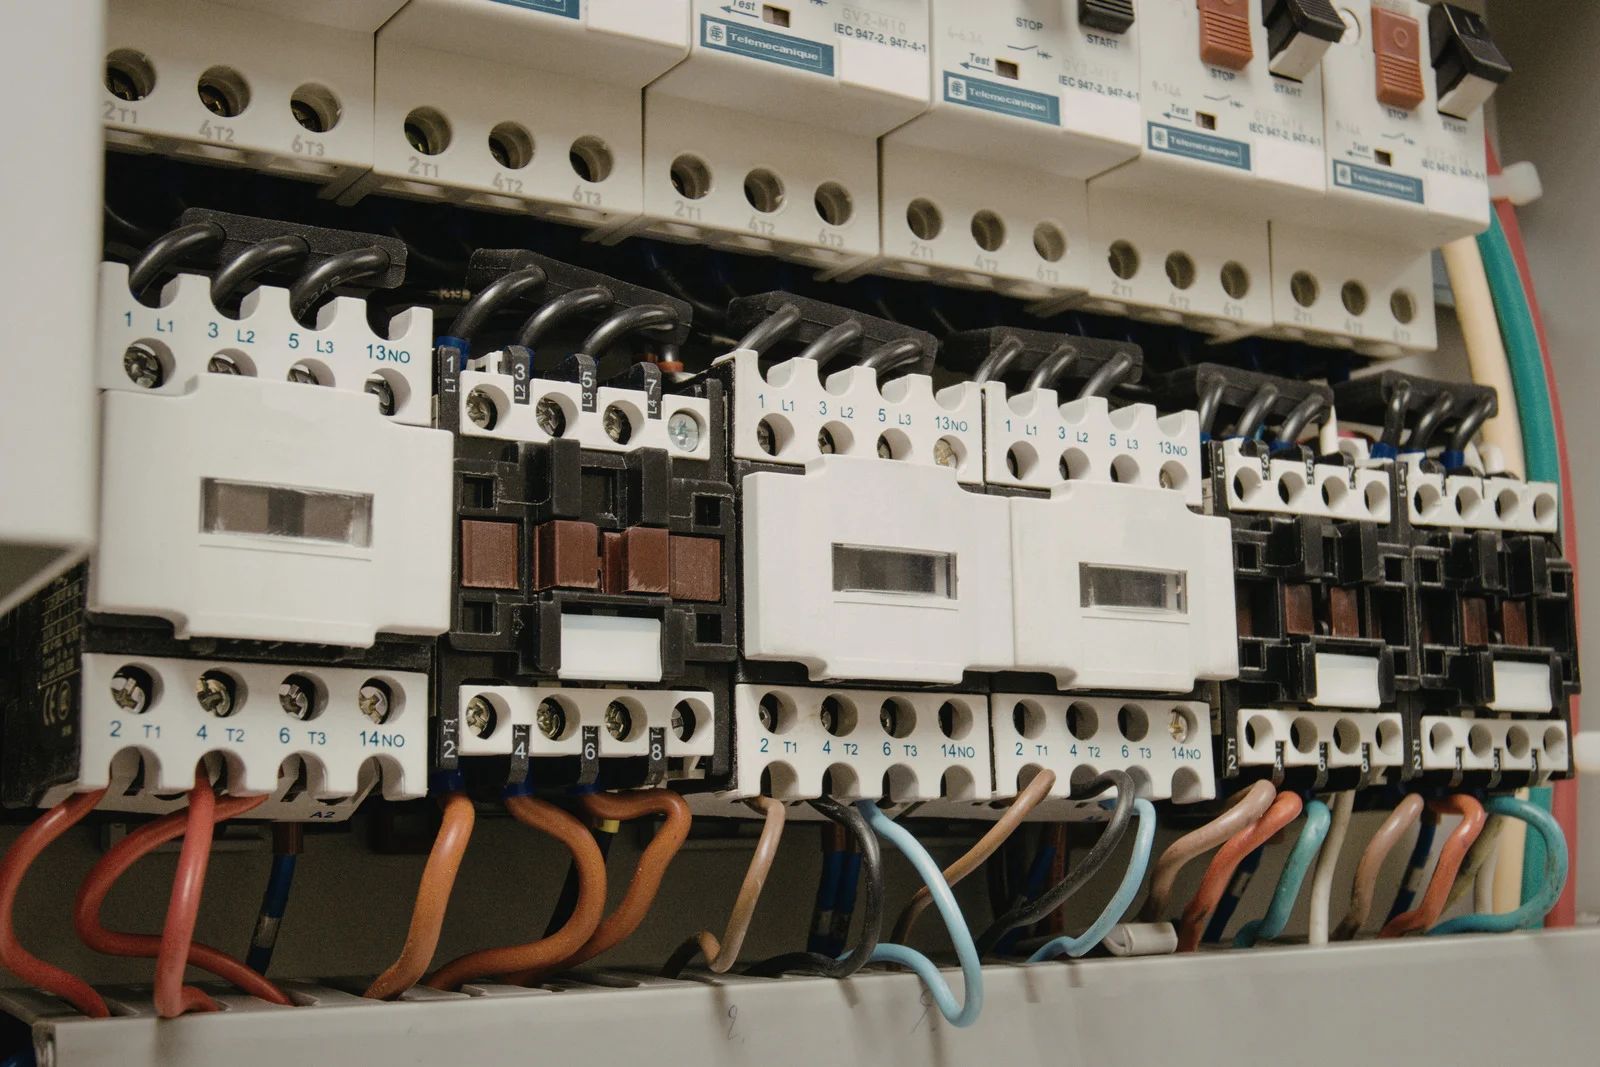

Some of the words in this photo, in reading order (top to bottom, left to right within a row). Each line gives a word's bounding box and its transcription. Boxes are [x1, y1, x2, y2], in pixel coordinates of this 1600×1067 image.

[1016, 17, 1043, 31] STOP
[834, 22, 853, 36] IEC
[890, 33, 926, 53] 947-4-1
[1087, 34, 1119, 49] START
[729, 32, 818, 61] Telemecanique
[969, 53, 990, 66] Test
[1058, 75, 1075, 87] IEC
[1211, 68, 1236, 81] STOP
[1274, 83, 1303, 97] START
[968, 87, 1047, 112] Telemecanique
[104, 100, 137, 124] 2T1
[199, 120, 234, 143] 4T2
[292, 135, 325, 157] 6T3
[408, 156, 439, 178] 2T1
[492, 172, 523, 193] 4T2
[572, 185, 601, 205] 6T3
[674, 201, 702, 219] 2T1
[124, 311, 132, 327] 1
[156, 318, 173, 332] L1
[208, 322, 219, 338] 3
[237, 329, 255, 344] L2
[288, 333, 300, 349] 5
[316, 340, 334, 354] L3
[447, 355, 454, 373] 1
[515, 363, 526, 381] 3
[445, 377, 456, 393] L1
[582, 371, 593, 388] 5
[647, 379, 657, 395] 7
[514, 384, 526, 400] L2
[582, 392, 593, 407] L3
[648, 400, 657, 414] L4
[758, 394, 764, 409] 1
[782, 399, 794, 412] L1
[819, 400, 827, 415] 3
[840, 406, 854, 419] L2
[878, 408, 886, 422] 5
[898, 413, 912, 425] L3
[1005, 419, 1011, 432] 1
[1026, 424, 1037, 436] L1
[1058, 426, 1066, 439] 3
[1076, 431, 1089, 443] L2
[1109, 433, 1117, 447] 5
[1127, 439, 1139, 450] L3
[1217, 448, 1223, 462] 1
[1261, 453, 1269, 469] 3
[1306, 459, 1314, 473] 5
[110, 720, 122, 737] 2
[142, 724, 161, 738] T1
[197, 724, 208, 740] 4
[225, 728, 245, 742] T2
[443, 718, 458, 735] T1
[279, 727, 290, 744] 6
[307, 731, 326, 745] T3
[443, 740, 456, 758] 2
[514, 741, 526, 759] 4
[584, 743, 596, 760] 6
[652, 744, 662, 760] 8
[760, 738, 769, 752] 2
[783, 741, 797, 753] T1
[822, 740, 831, 754] 4
[843, 743, 858, 755] T2
[883, 742, 891, 756] 6
[903, 745, 917, 757] T3
[1015, 742, 1024, 755] 2
[1035, 745, 1048, 756] T1
[1070, 744, 1077, 757] 4
[1087, 746, 1101, 758] T2
[1121, 745, 1129, 758] 6
[1139, 747, 1152, 759] T3
[1228, 754, 1237, 769] 2
[1274, 756, 1282, 771] 4
[1414, 755, 1421, 770] 2
[310, 811, 336, 819] A2
